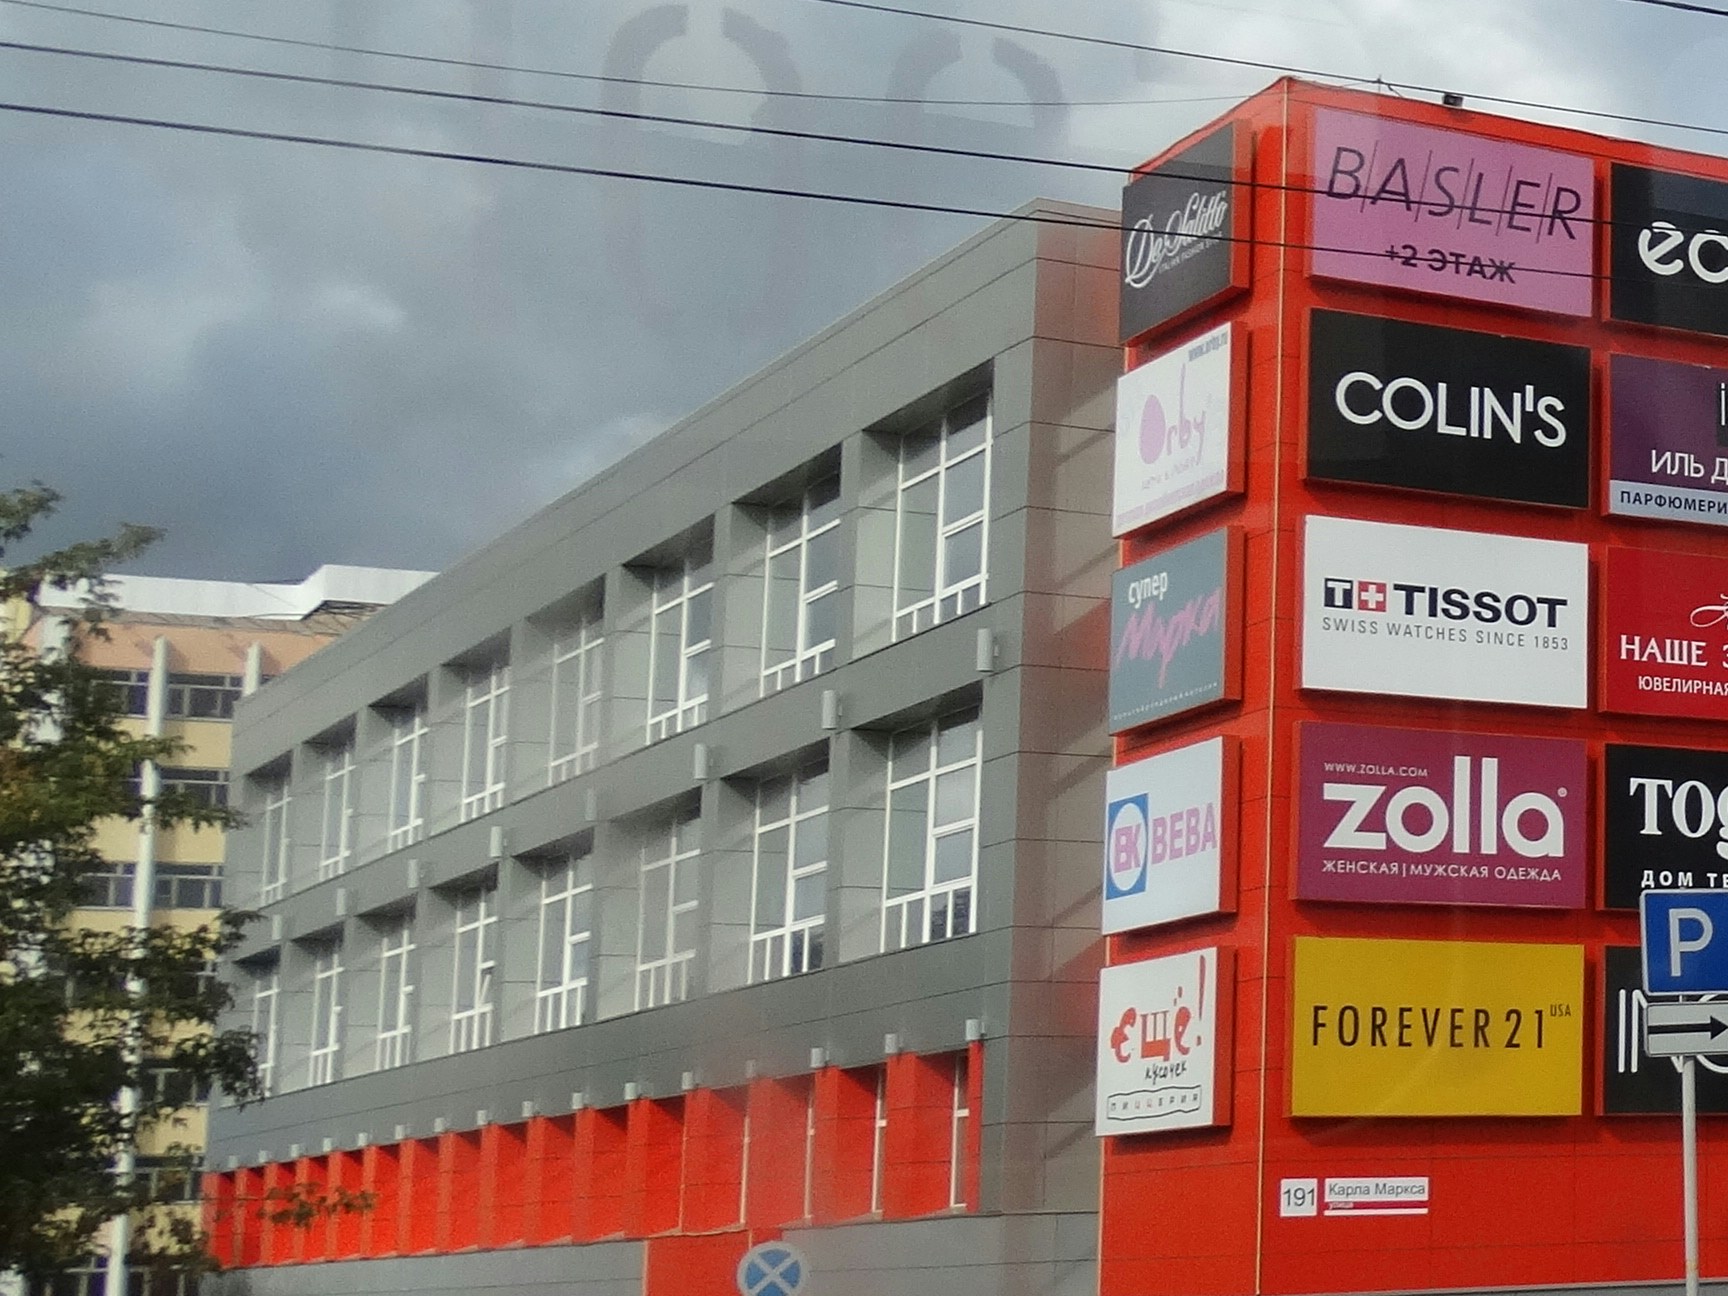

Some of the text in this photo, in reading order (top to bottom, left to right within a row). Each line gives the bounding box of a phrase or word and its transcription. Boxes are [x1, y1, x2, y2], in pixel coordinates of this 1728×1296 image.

[1428, 249, 1516, 284] ЭТАЖ
[1335, 371, 1567, 448] COLIN'S
[1651, 449, 1704, 478] ИЛЬ
[1393, 583, 1568, 628] TISSOT
[1322, 617, 1569, 651] SWISS WATCHES SINCE 1853
[1620, 635, 1708, 667] НАШЕ
[1324, 762, 1428, 777] WWW.ZOLLA.COM
[1323, 755, 1565, 859] zolla
[1322, 859, 1562, 882] ЖЕНСКАЯ МУЖСКАЯ ОДЕЖДА
[1641, 870, 1693, 888] ДОМ
[1669, 908, 1714, 977] P
[1312, 1004, 1571, 1049] FOREVER 21 USA
[1283, 1187, 1316, 1207] 191
[1329, 1182, 1426, 1198] Карла Маркса
